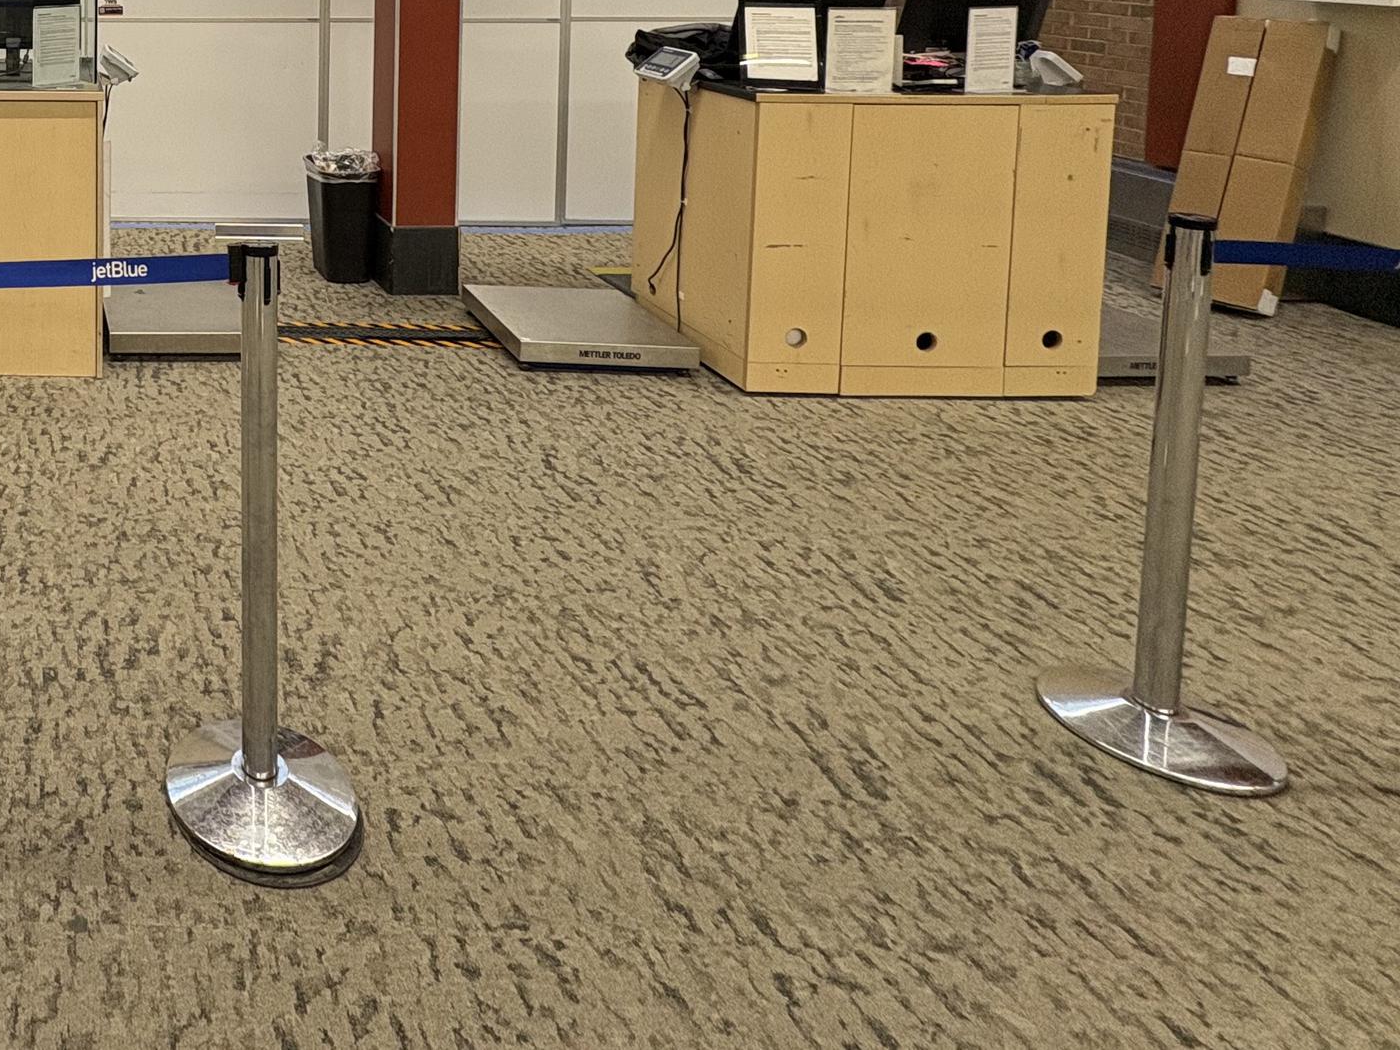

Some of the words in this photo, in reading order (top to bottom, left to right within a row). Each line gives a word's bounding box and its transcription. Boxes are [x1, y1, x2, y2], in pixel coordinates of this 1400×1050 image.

[91, 261, 148, 282] jetBlue
[579, 350, 611, 358] METTLER
[612, 351, 641, 360] TOLEDO
[1130, 362, 1157, 370] METTLE
